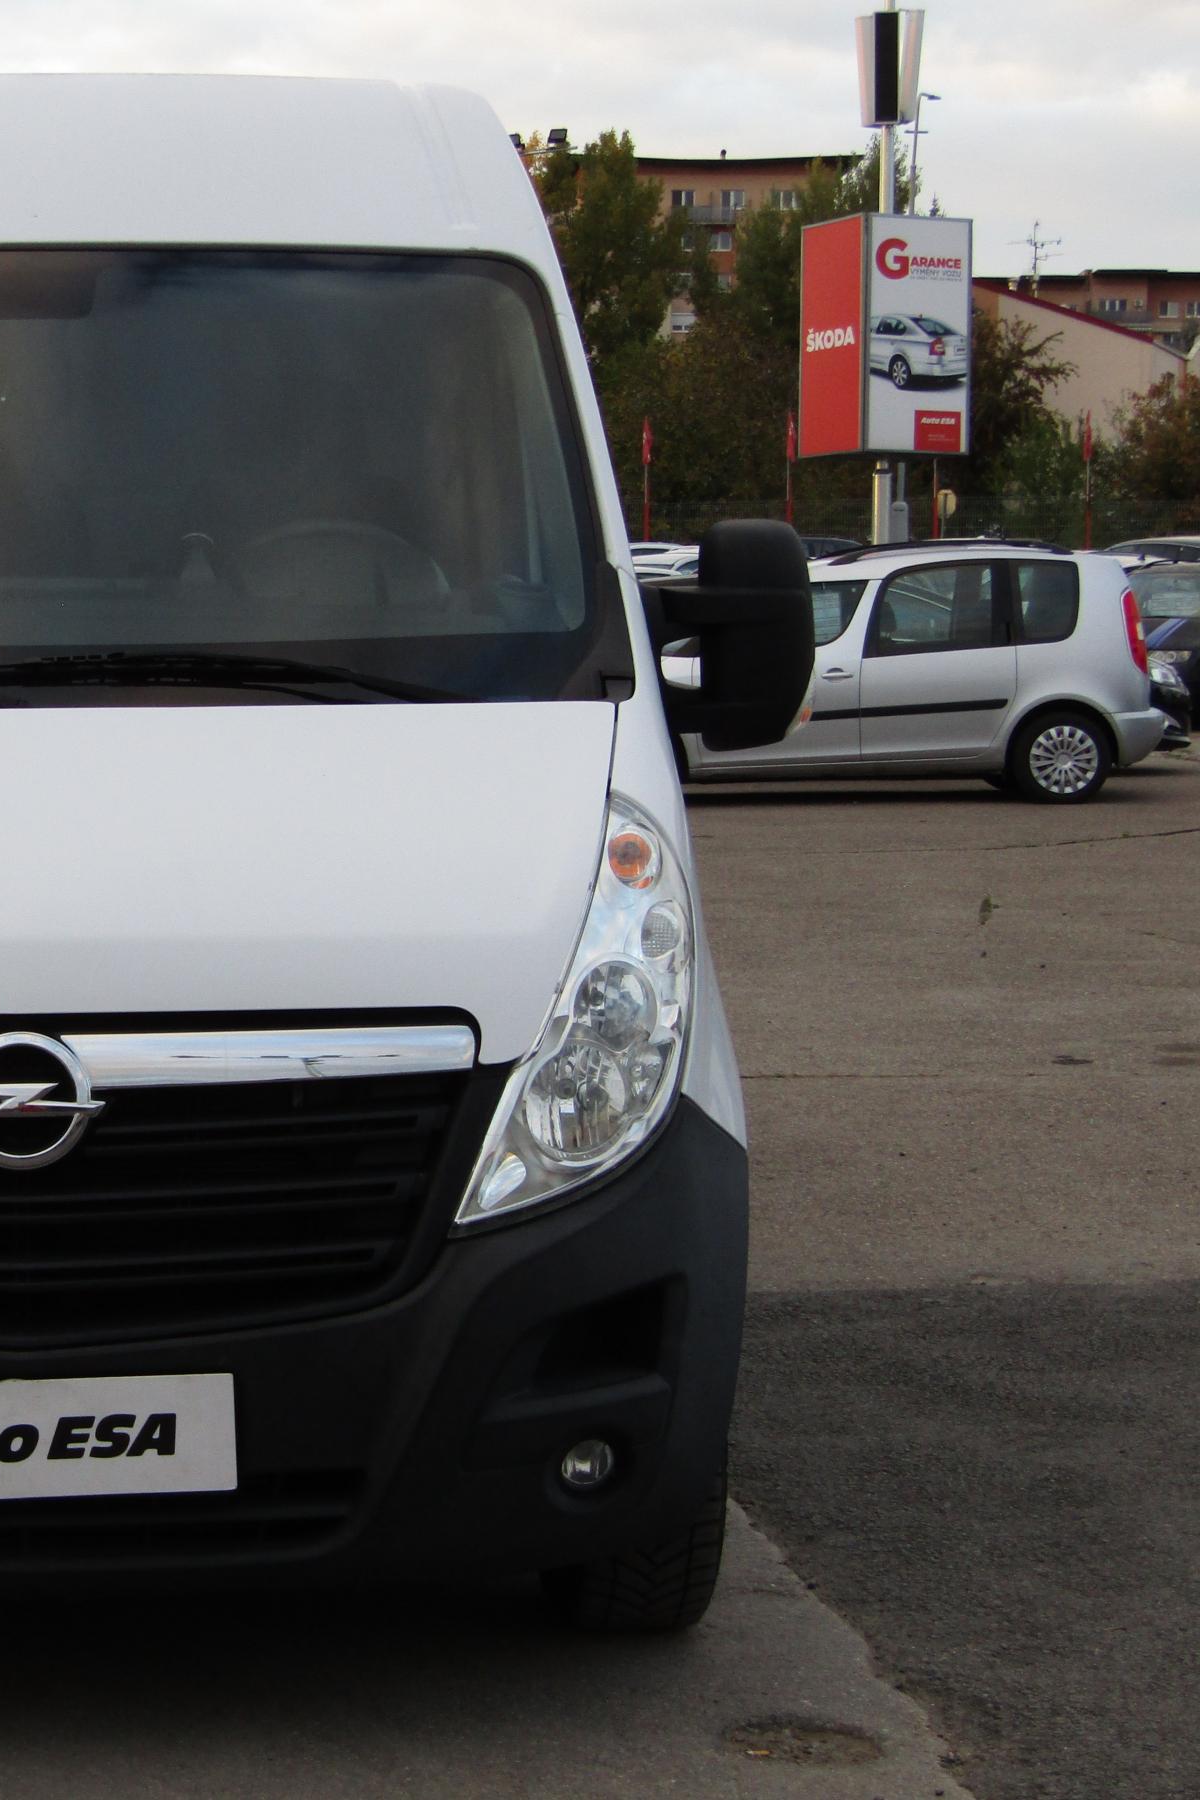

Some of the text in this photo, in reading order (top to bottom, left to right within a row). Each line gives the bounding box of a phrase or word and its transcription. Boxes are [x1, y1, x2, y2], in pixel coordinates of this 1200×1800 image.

[875, 238, 962, 280] GARANCE
[806, 325, 855, 352] ŠKODA
[46, 1412, 177, 1460] ESA
